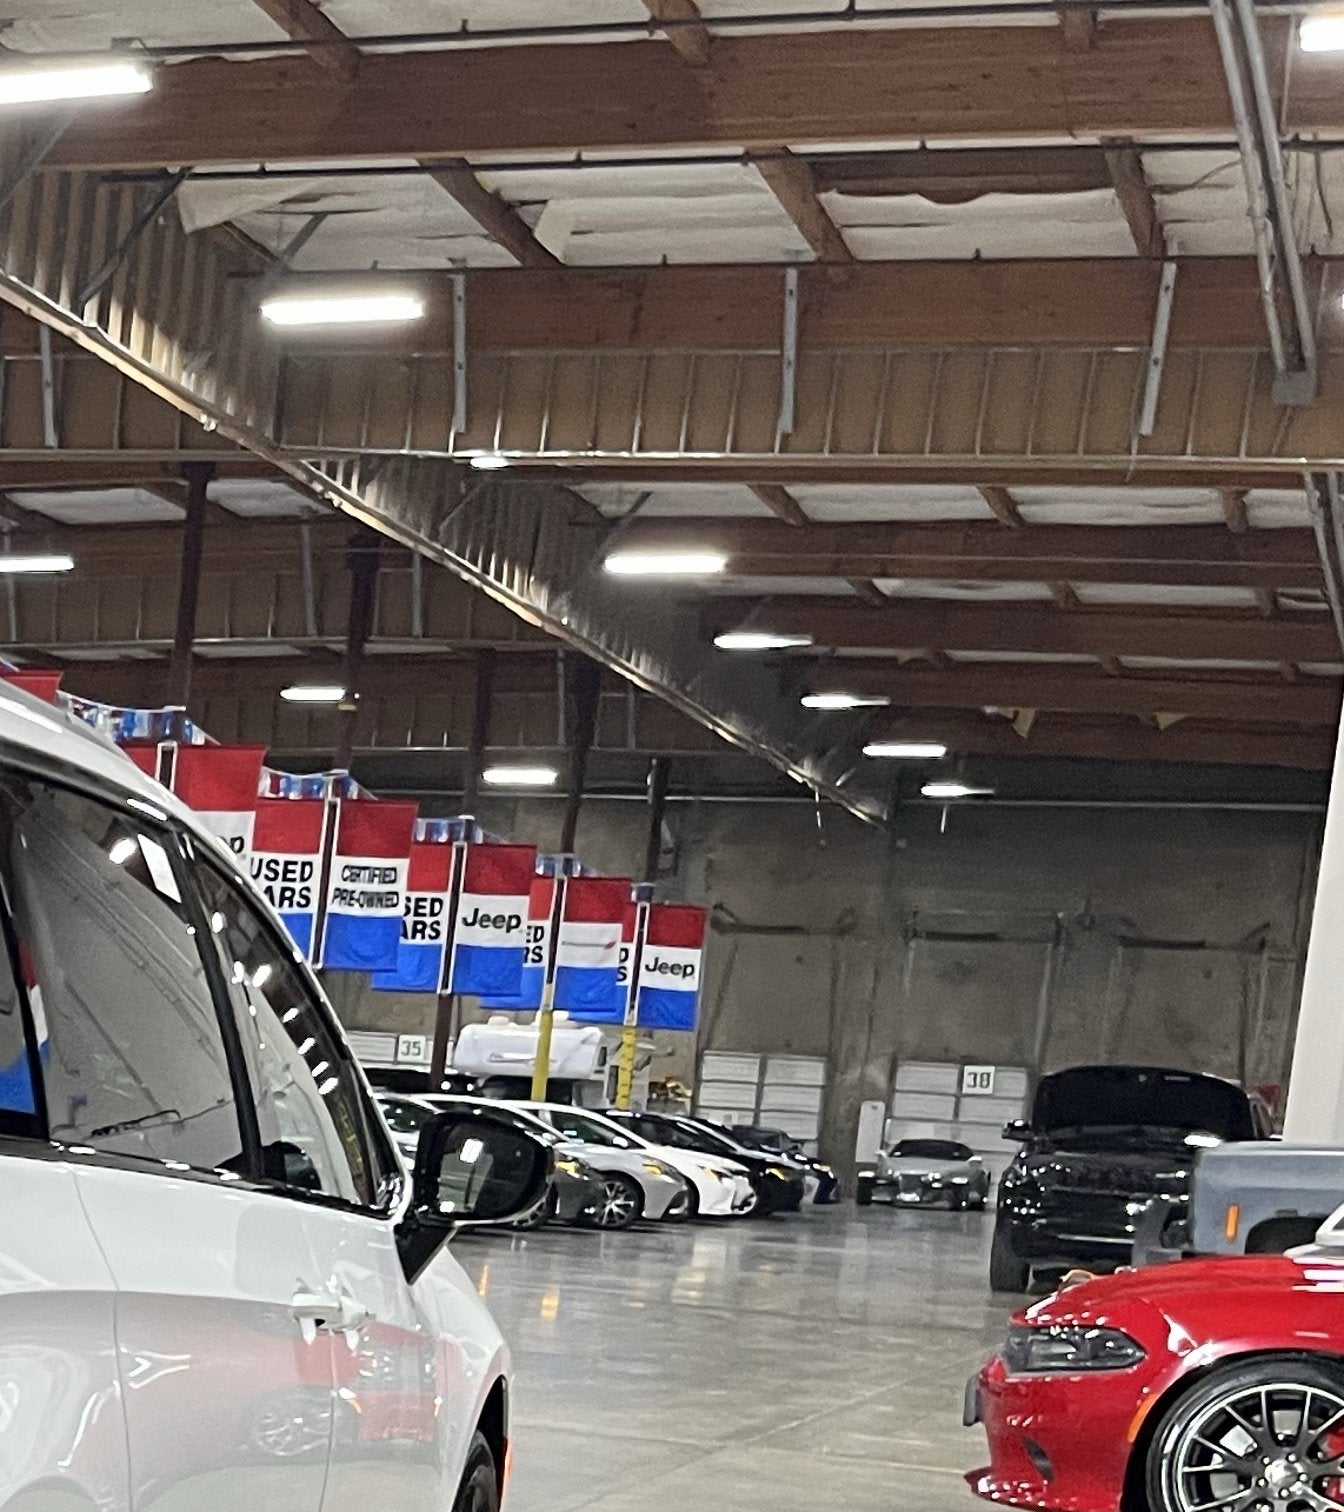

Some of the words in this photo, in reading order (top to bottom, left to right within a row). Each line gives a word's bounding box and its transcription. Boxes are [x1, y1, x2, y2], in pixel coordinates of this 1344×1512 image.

[250, 857, 313, 883] USED
[263, 885, 312, 909] ARS
[403, 896, 444, 918] SED
[462, 907, 522, 934] Jeep
[644, 956, 696, 979] Jeep
[400, 1040, 421, 1057] 35
